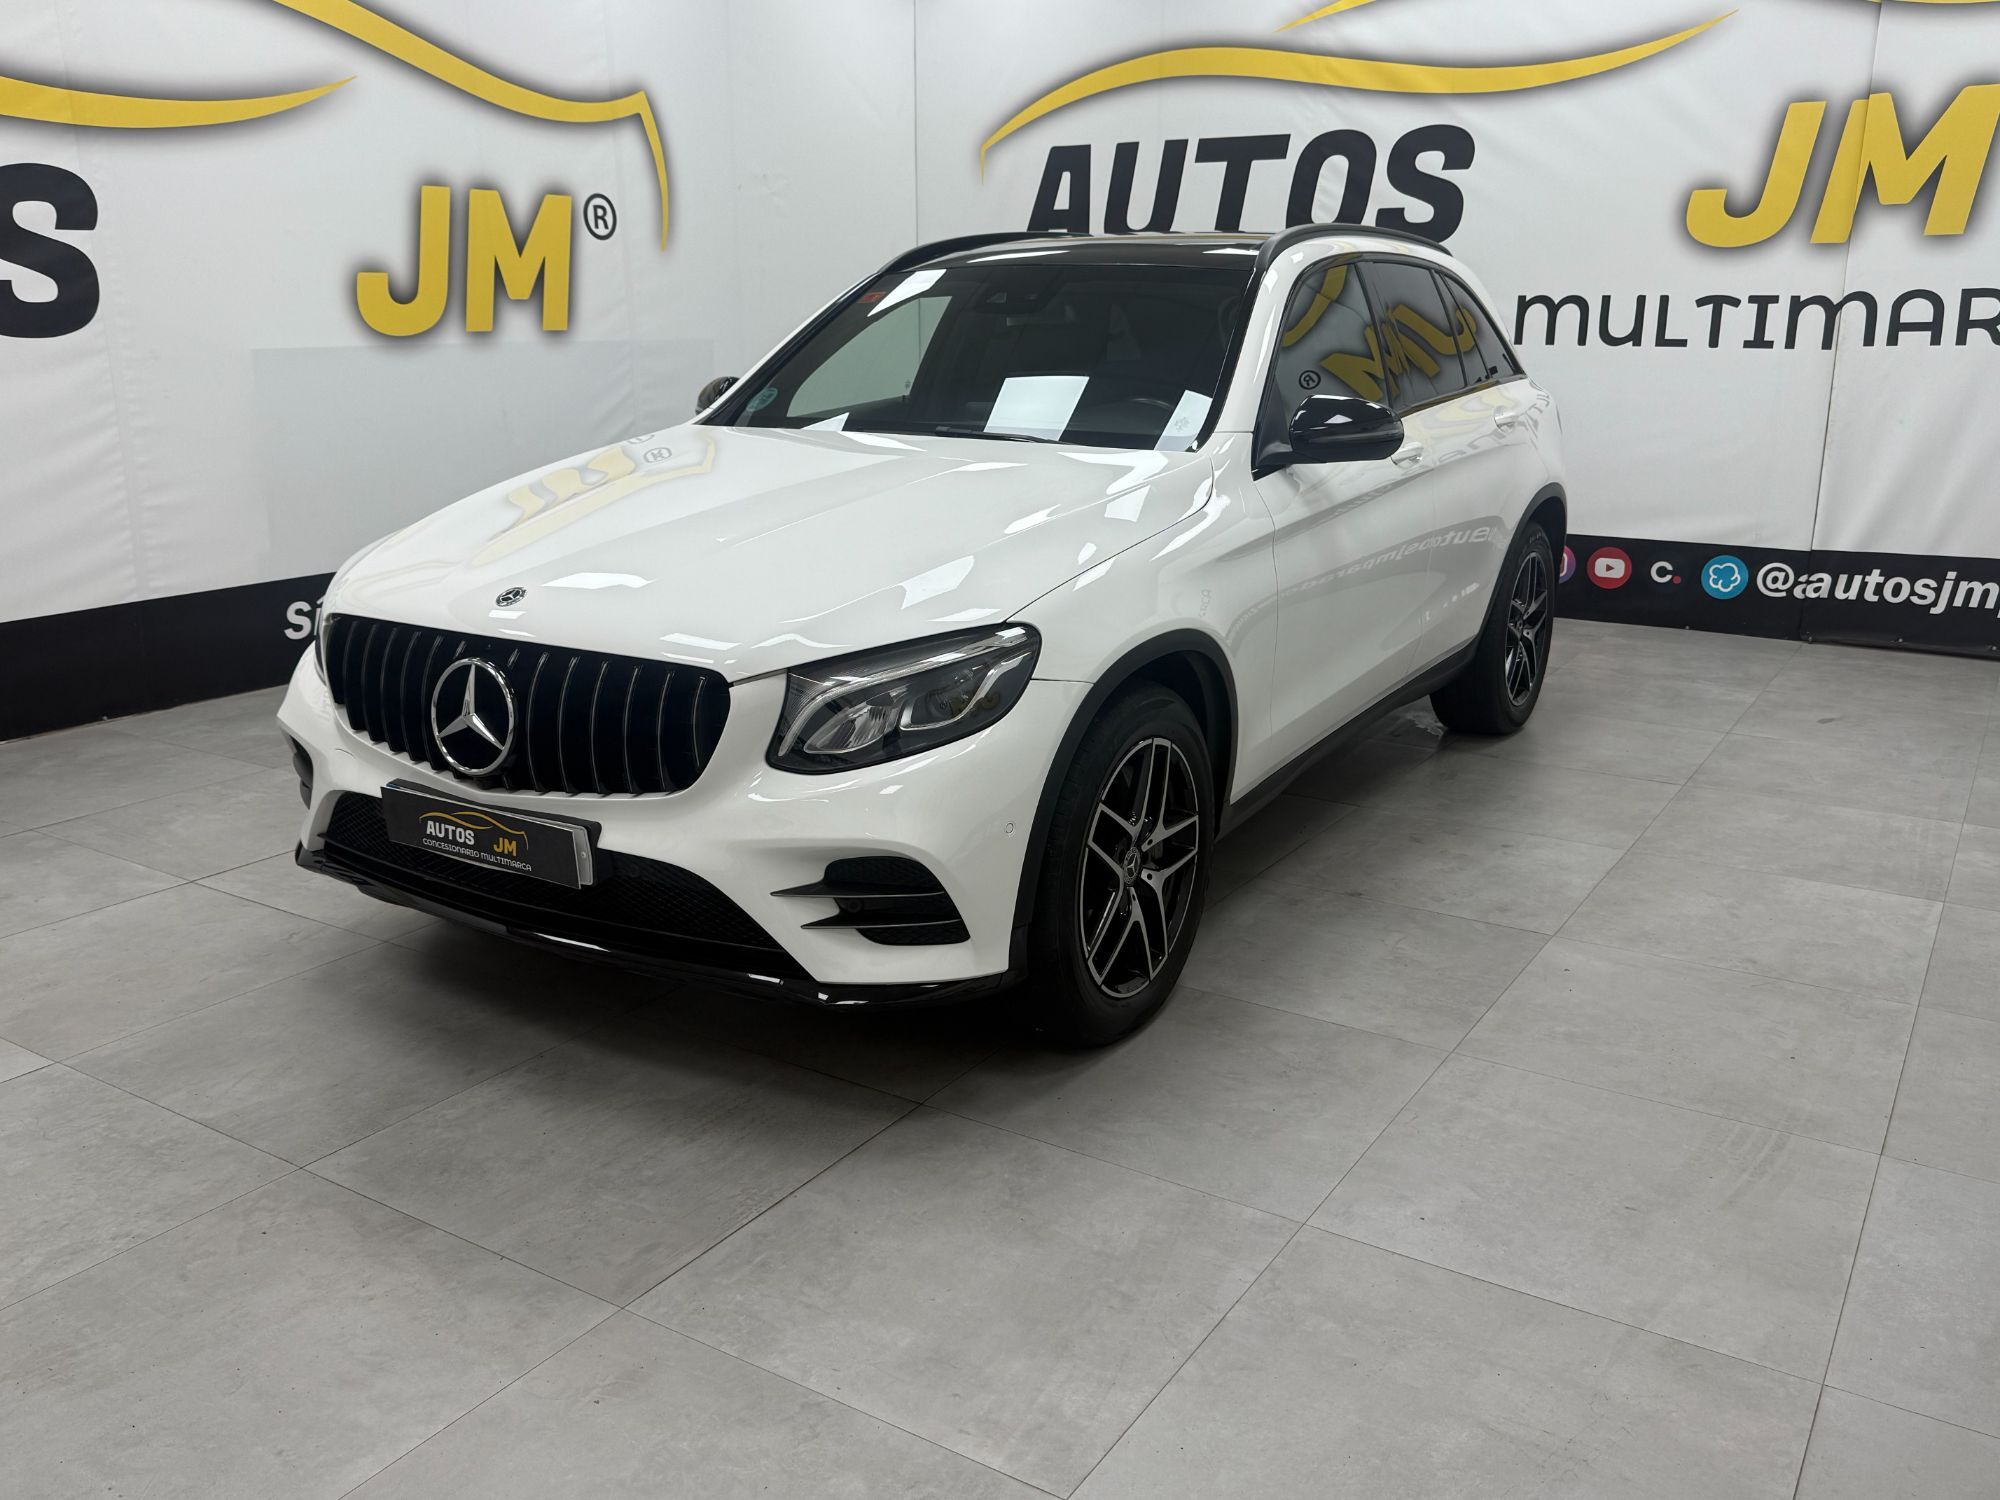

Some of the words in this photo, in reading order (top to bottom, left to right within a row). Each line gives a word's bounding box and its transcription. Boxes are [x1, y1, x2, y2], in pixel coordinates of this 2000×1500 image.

[1027, 124, 1476, 243] AUTOS
[1686, 84, 2000, 248] JM
[426, 820, 475, 846] AUTOS
[493, 837, 517, 857] JM
